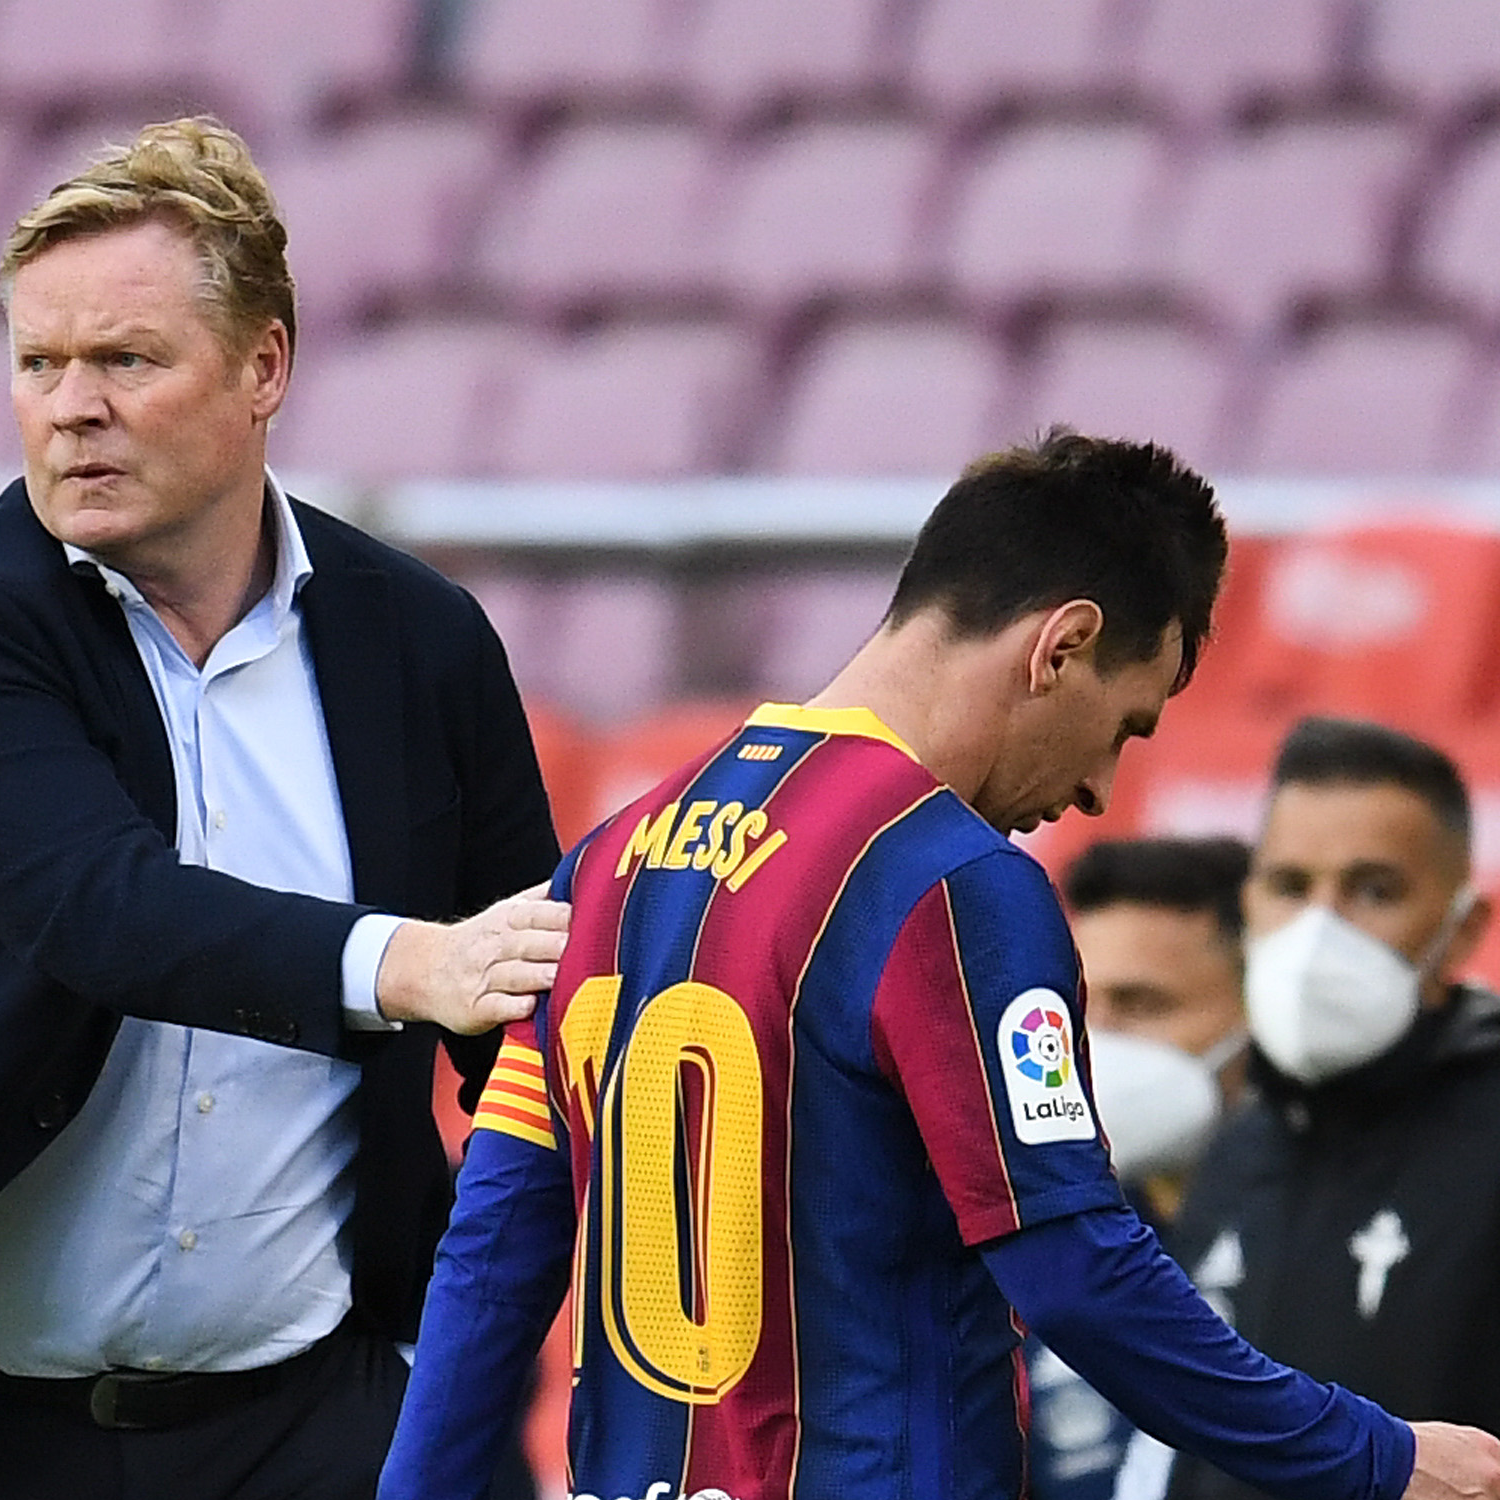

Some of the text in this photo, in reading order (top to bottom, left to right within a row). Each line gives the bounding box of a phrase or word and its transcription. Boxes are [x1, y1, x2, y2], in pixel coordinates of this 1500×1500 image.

[614, 800, 789, 894] MESSI
[1023, 1096, 1085, 1122] LaLiga
[557, 974, 765, 1406] 10
